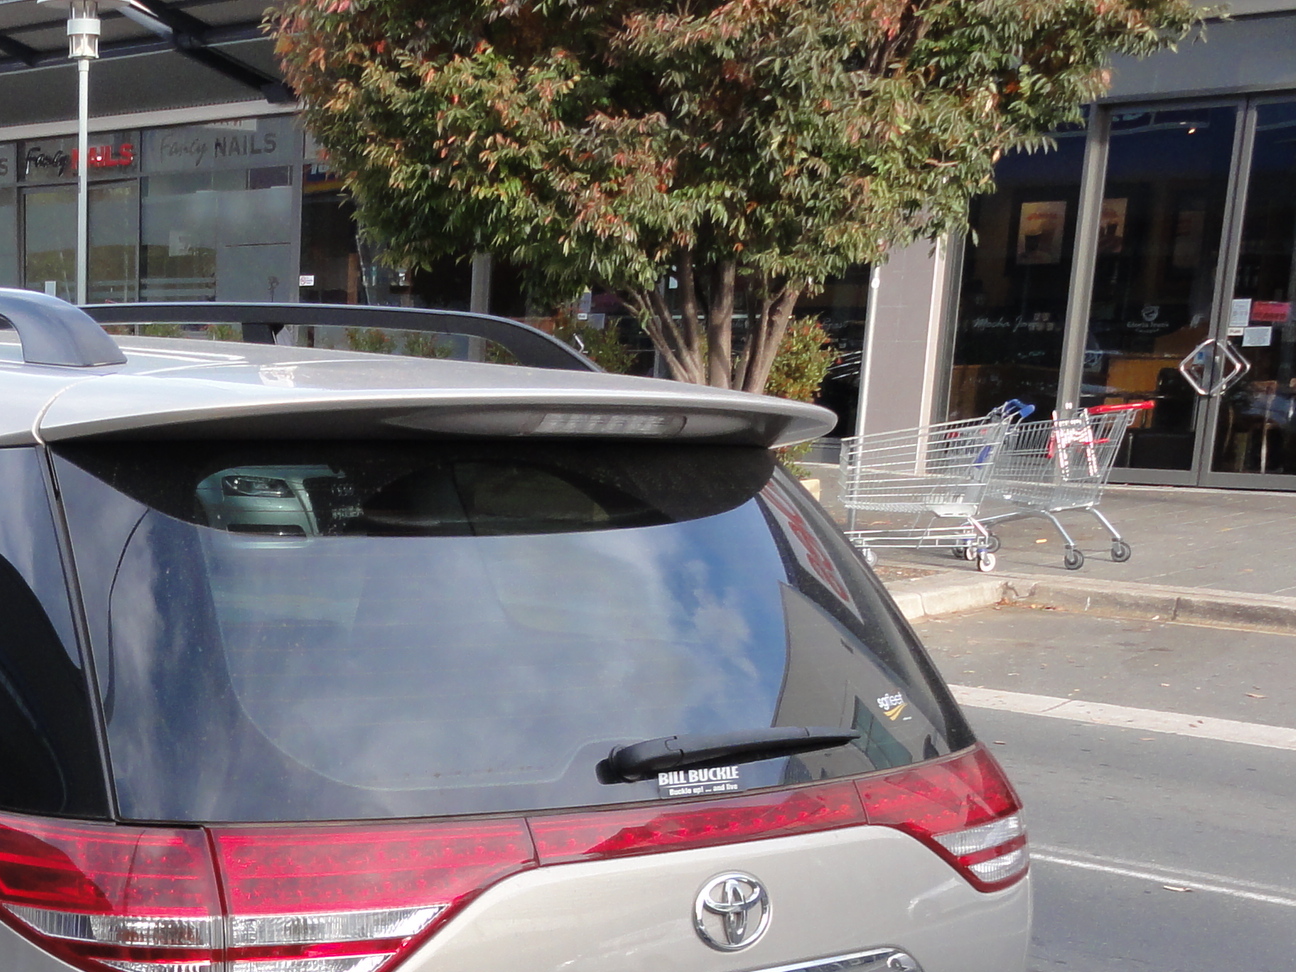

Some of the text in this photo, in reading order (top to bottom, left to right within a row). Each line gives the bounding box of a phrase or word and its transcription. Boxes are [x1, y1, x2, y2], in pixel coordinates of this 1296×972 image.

[214, 132, 277, 159] NAILS
[658, 766, 739, 786] BILL BUCKLE
[713, 784, 725, 792] and
